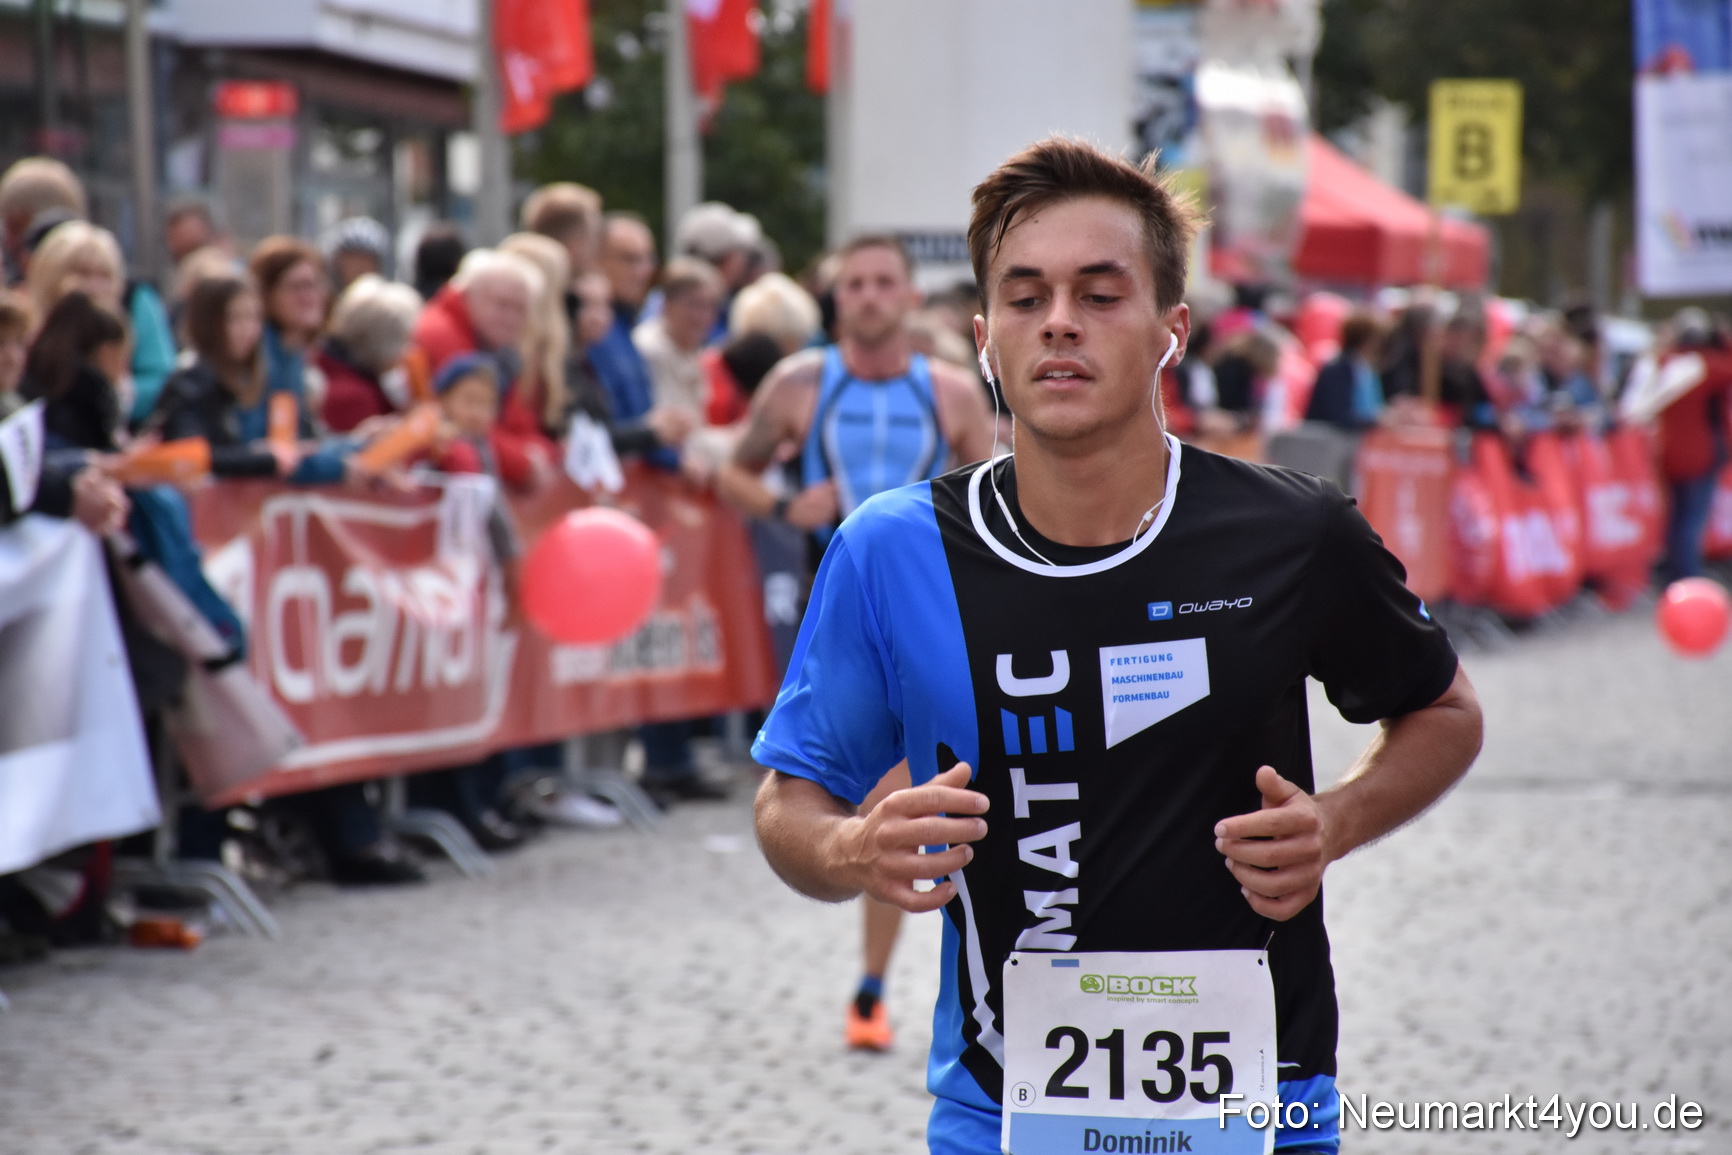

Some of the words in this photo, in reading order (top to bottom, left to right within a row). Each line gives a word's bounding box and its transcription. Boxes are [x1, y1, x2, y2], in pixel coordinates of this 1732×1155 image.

[1110, 653, 1173, 666] FERTIGUNG
[1111, 671, 1183, 685] MASCHINENBAU
[1112, 690, 1170, 703] FORMENBAU
[996, 650, 1081, 951] MATEC
[1107, 975, 1198, 996] BOCK
[1107, 995, 1134, 1003] inspired
[1136, 996, 1145, 1004] by
[1045, 1026, 1234, 1104] 2135
[1018, 1088, 1028, 1102] B
[1083, 1128, 1193, 1154] Dominik
